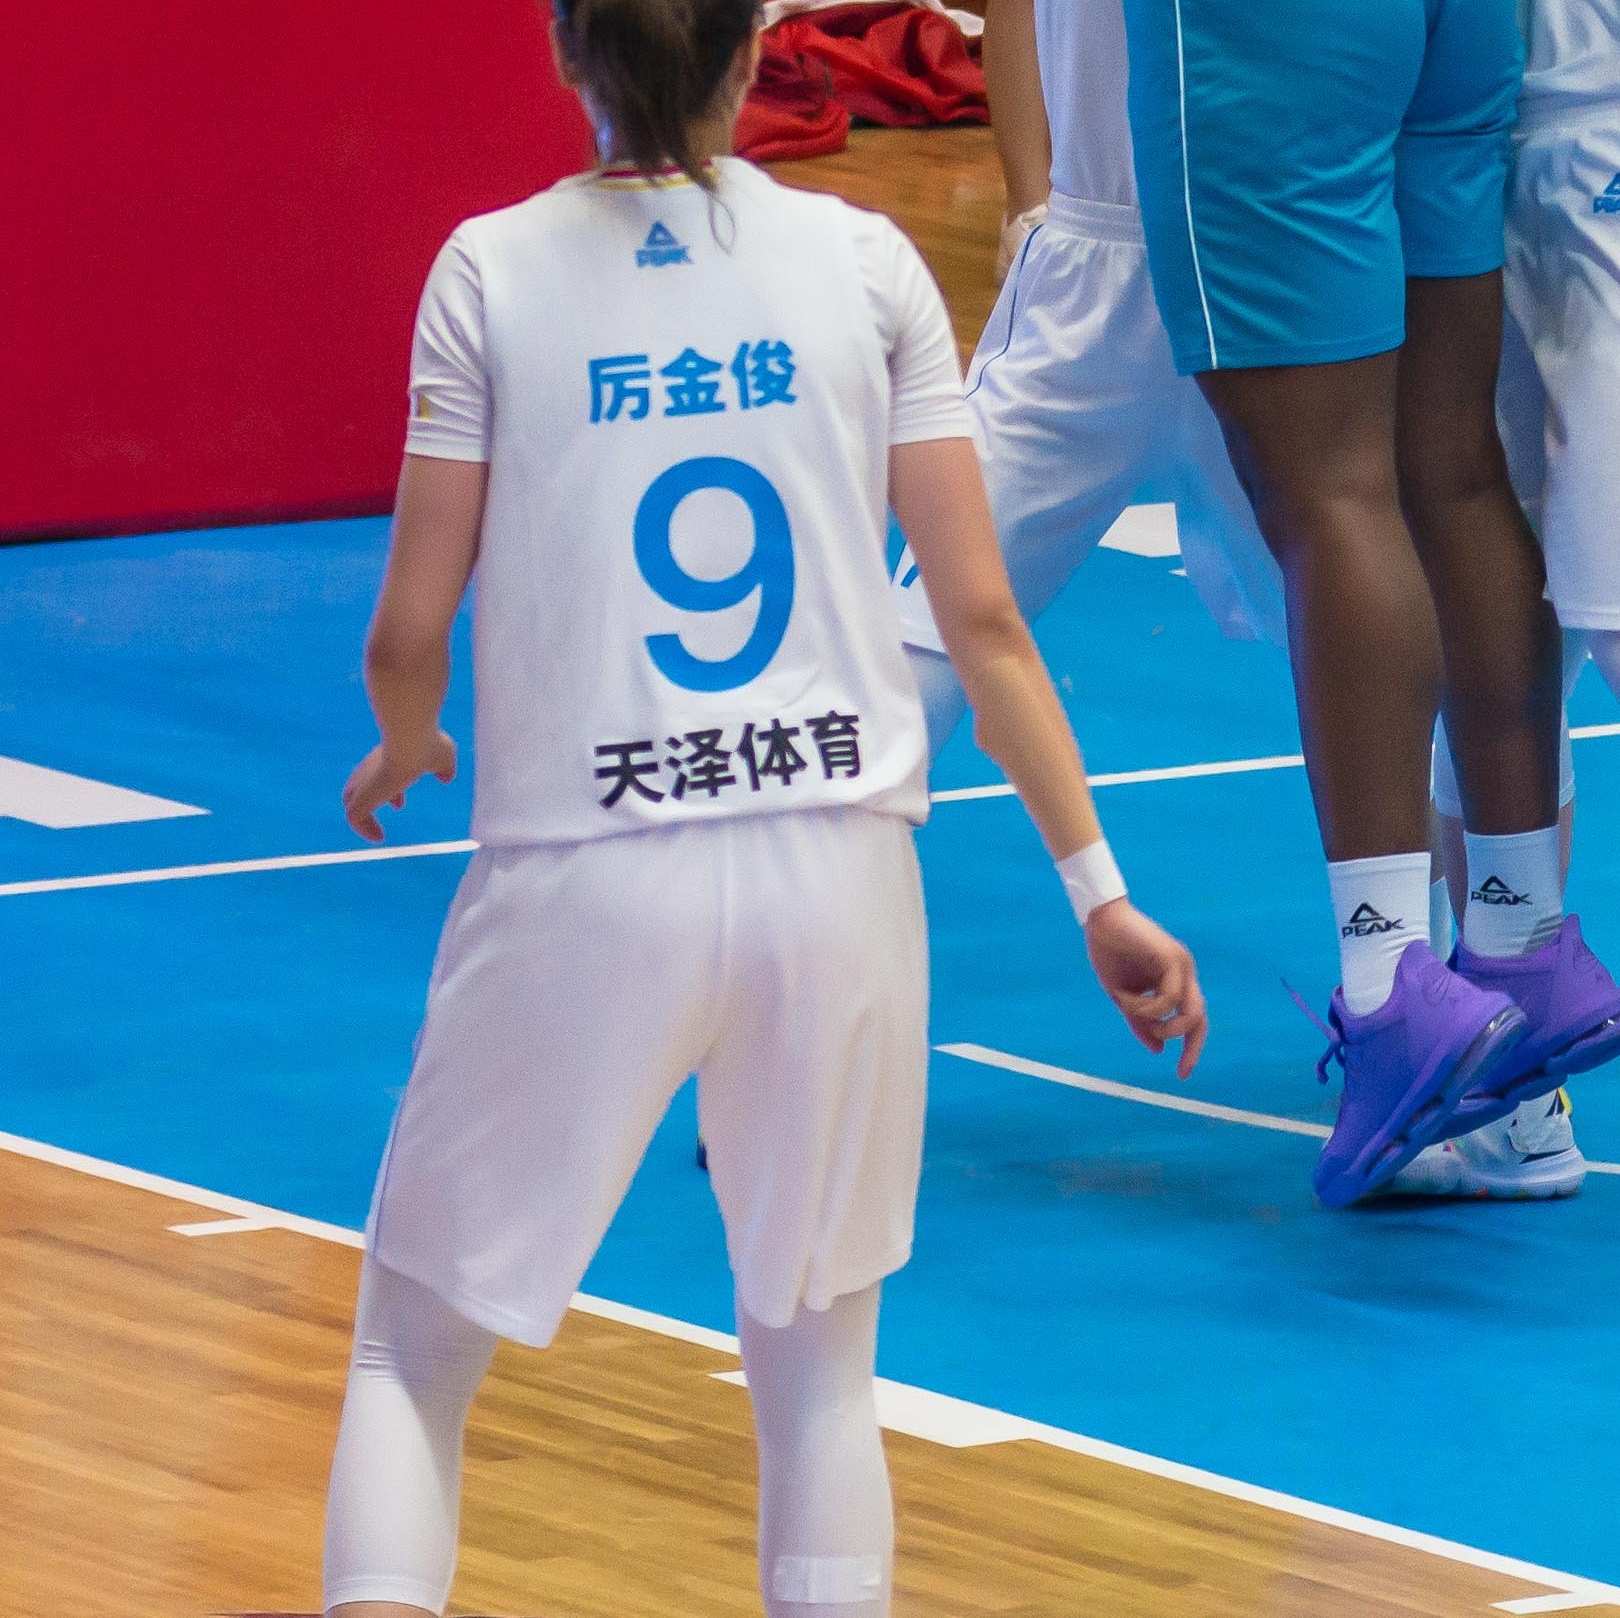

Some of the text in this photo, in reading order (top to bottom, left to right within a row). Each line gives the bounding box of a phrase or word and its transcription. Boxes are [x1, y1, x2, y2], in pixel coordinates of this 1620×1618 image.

[587, 338, 798, 424] 厉金俊
[633, 456, 796, 694] 9
[594, 709, 863, 810] 天泽体育
[1341, 918, 1406, 939] PEAK
[1470, 890, 1533, 906] PEAK
